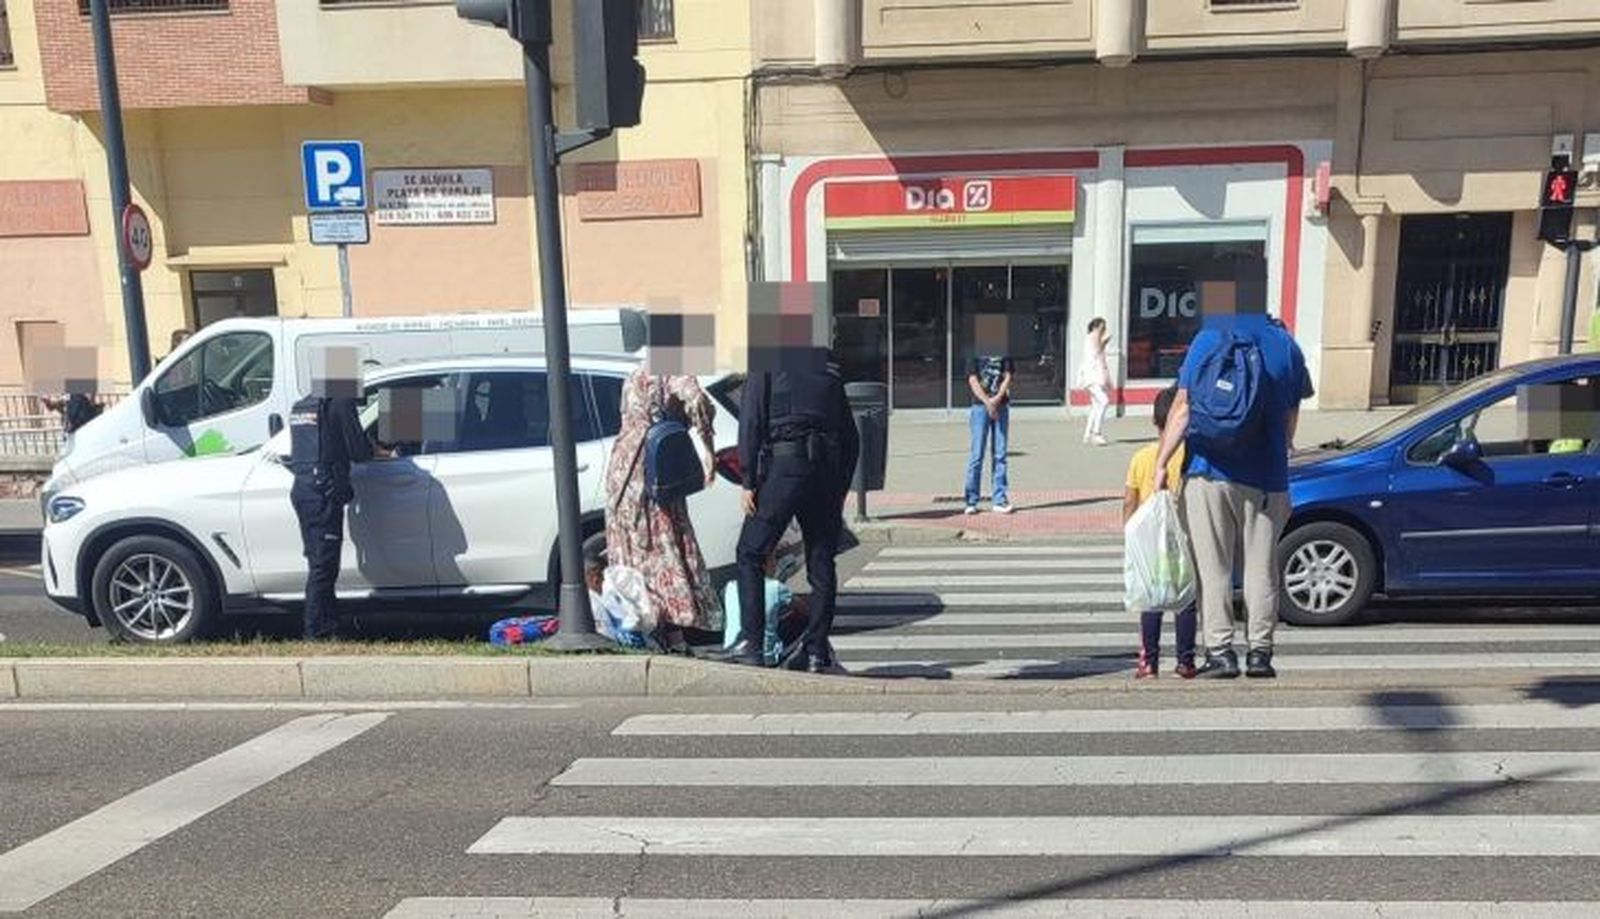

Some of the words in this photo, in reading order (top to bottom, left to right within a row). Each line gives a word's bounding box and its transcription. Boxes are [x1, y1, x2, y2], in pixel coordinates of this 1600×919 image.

[314, 150, 352, 201] P
[906, 186, 954, 209] Dia
[131, 228, 148, 248] 40
